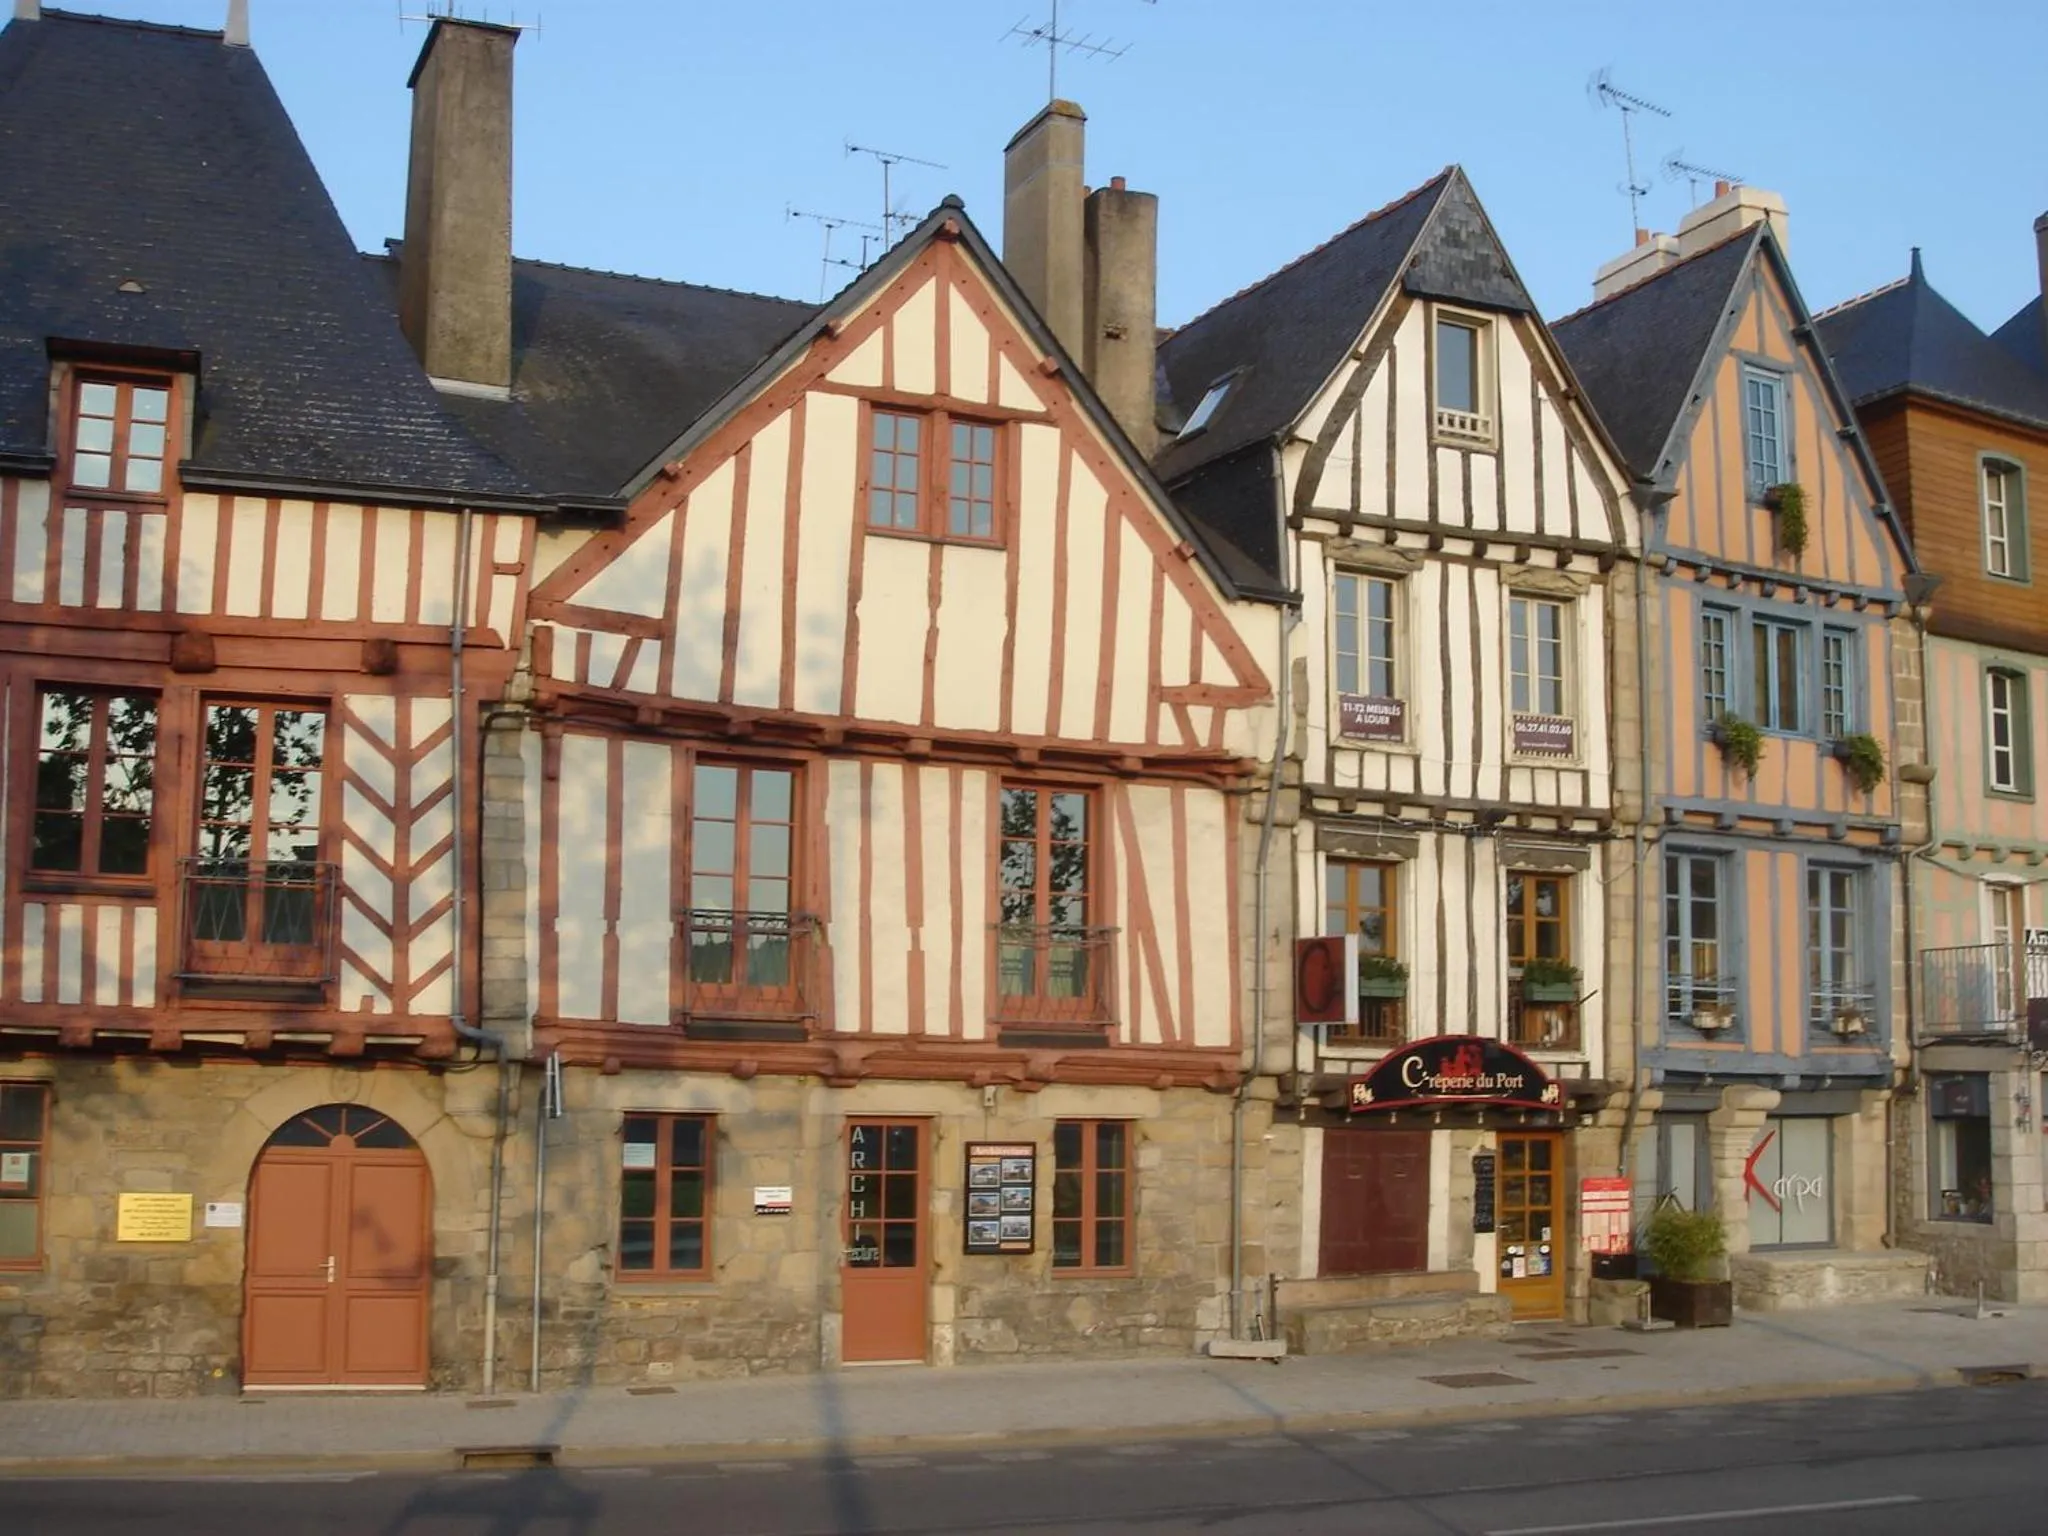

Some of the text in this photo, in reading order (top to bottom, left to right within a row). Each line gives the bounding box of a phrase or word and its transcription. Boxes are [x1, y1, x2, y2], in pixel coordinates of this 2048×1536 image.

[1363, 714, 1391, 726] LOUER
[1475, 1072, 1494, 1089] du
[1496, 1072, 1524, 1089] Port
[1743, 1129, 1823, 1216] Karpa
